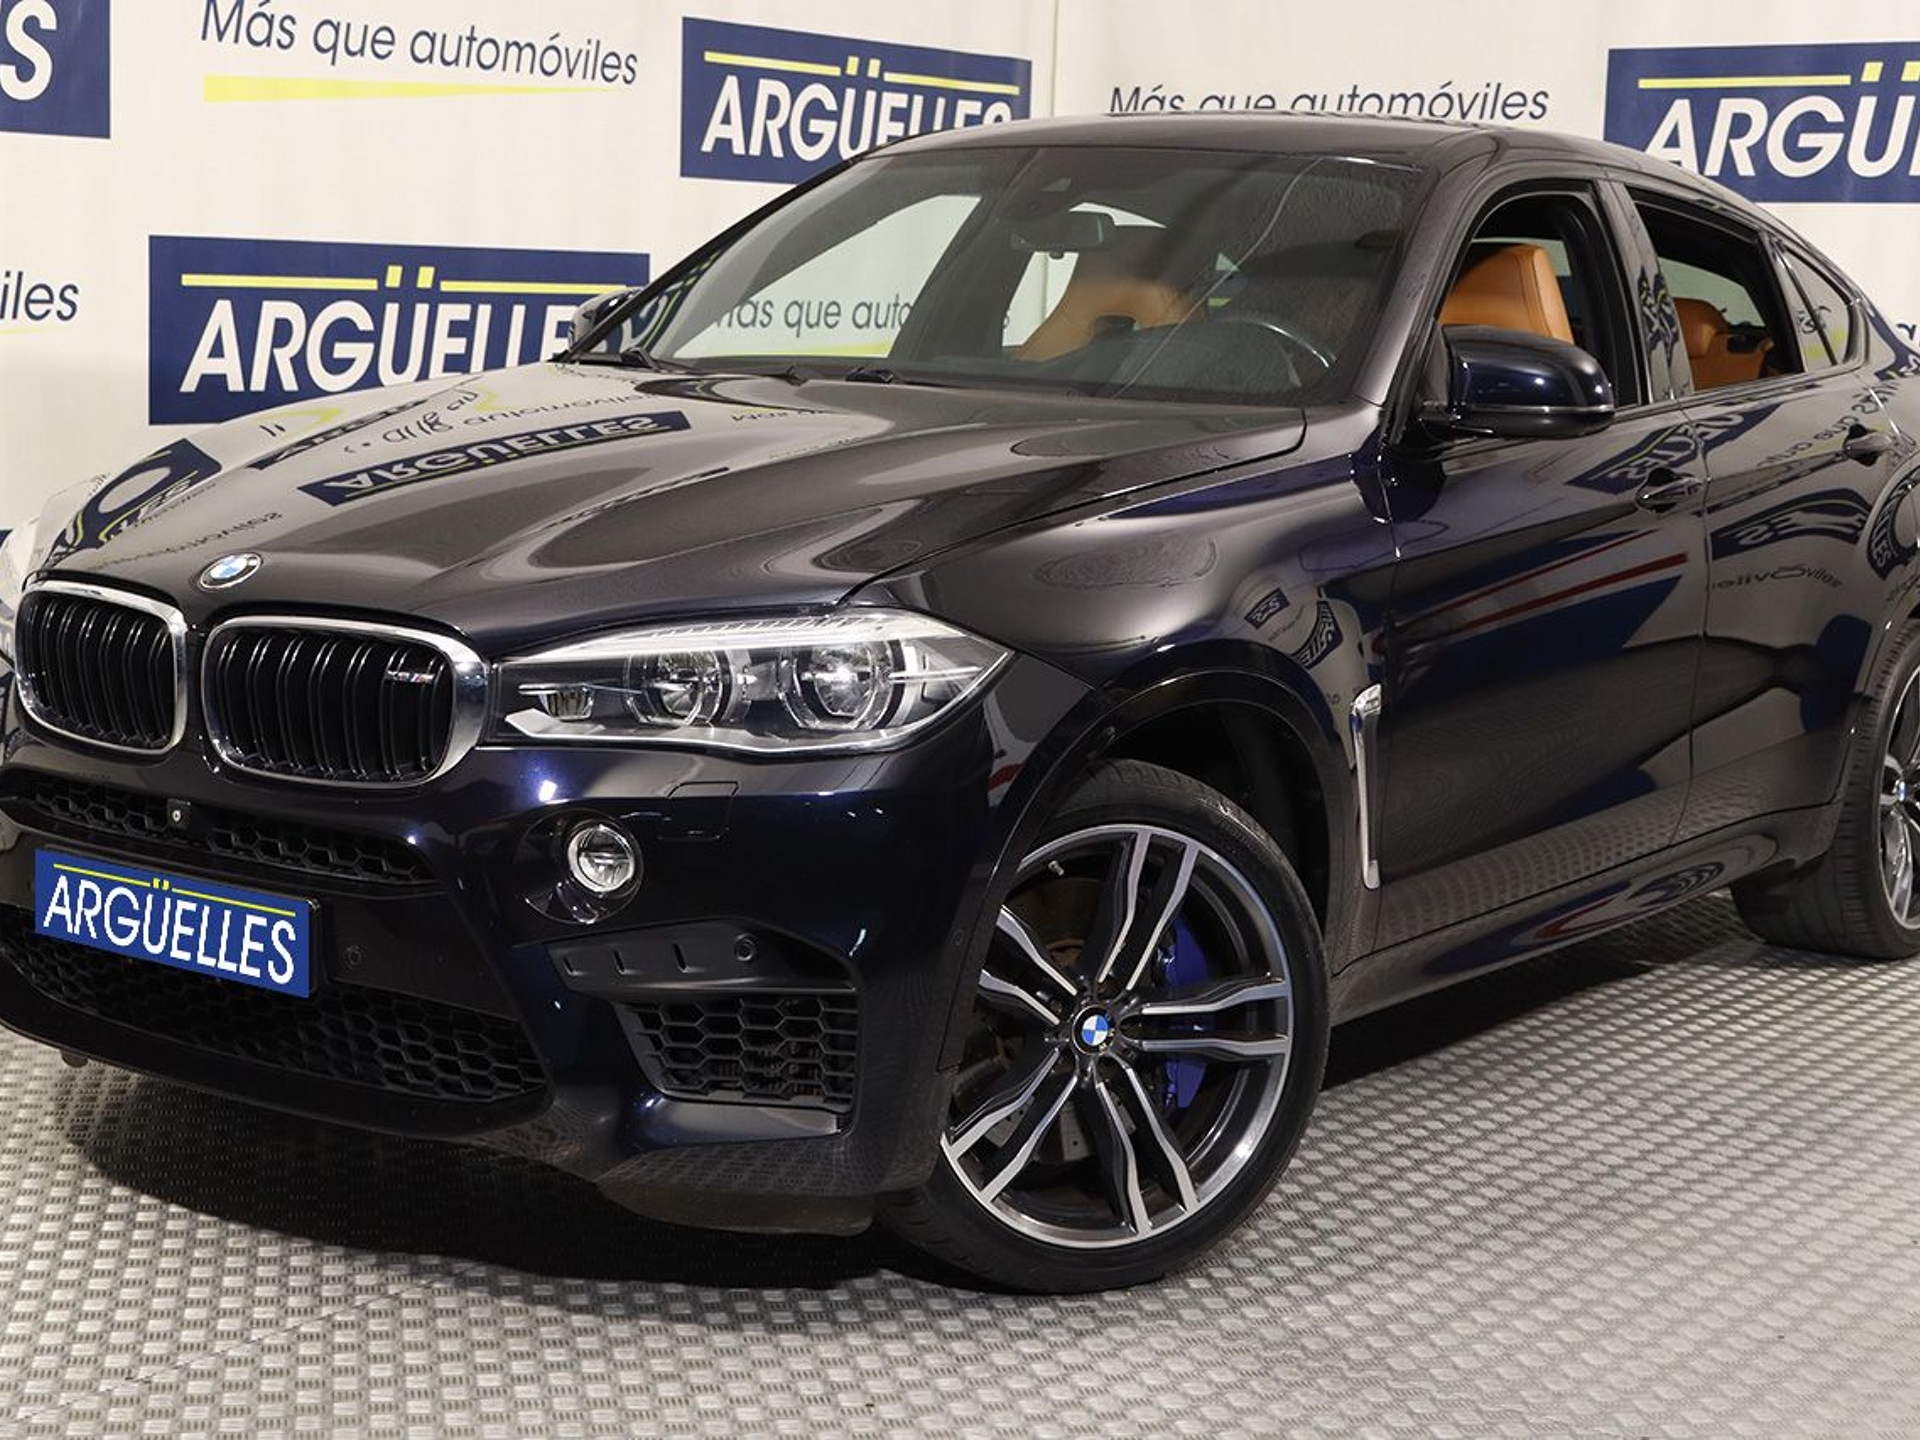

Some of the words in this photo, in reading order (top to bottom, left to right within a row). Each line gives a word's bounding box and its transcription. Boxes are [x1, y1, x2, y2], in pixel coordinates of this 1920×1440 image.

[201, 0, 297, 50] Más
[313, 18, 396, 66] que
[410, 25, 638, 84] automóviles
[1645, 61, 1920, 178] ARGÜ
[179, 265, 577, 393] ARGÜELLE
[784, 298, 842, 338] que
